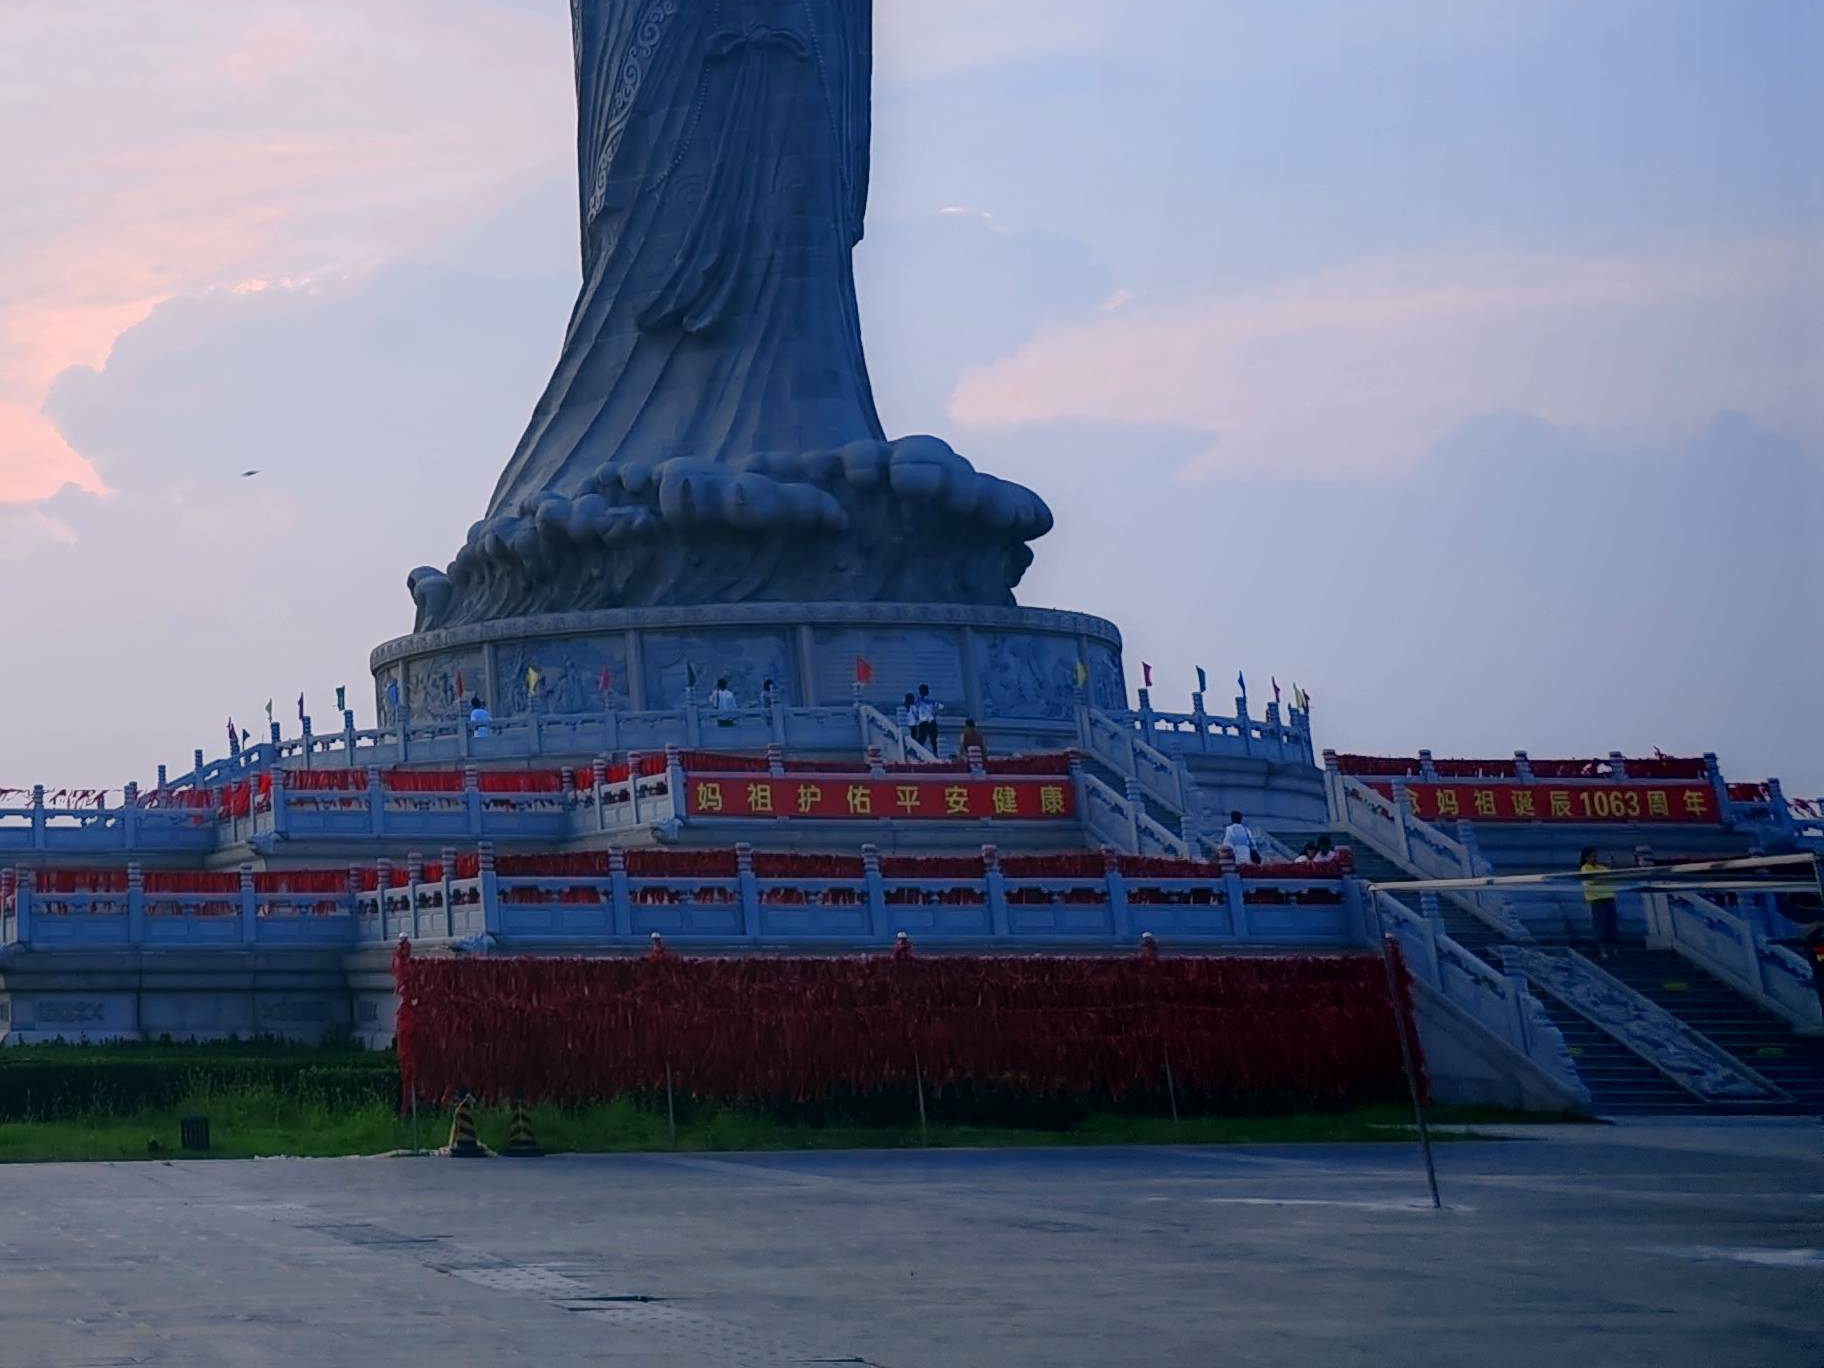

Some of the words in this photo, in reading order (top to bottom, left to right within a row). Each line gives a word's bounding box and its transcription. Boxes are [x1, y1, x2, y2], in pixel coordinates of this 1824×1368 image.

[696, 782, 1066, 814] 妈祖护佑平安健康
